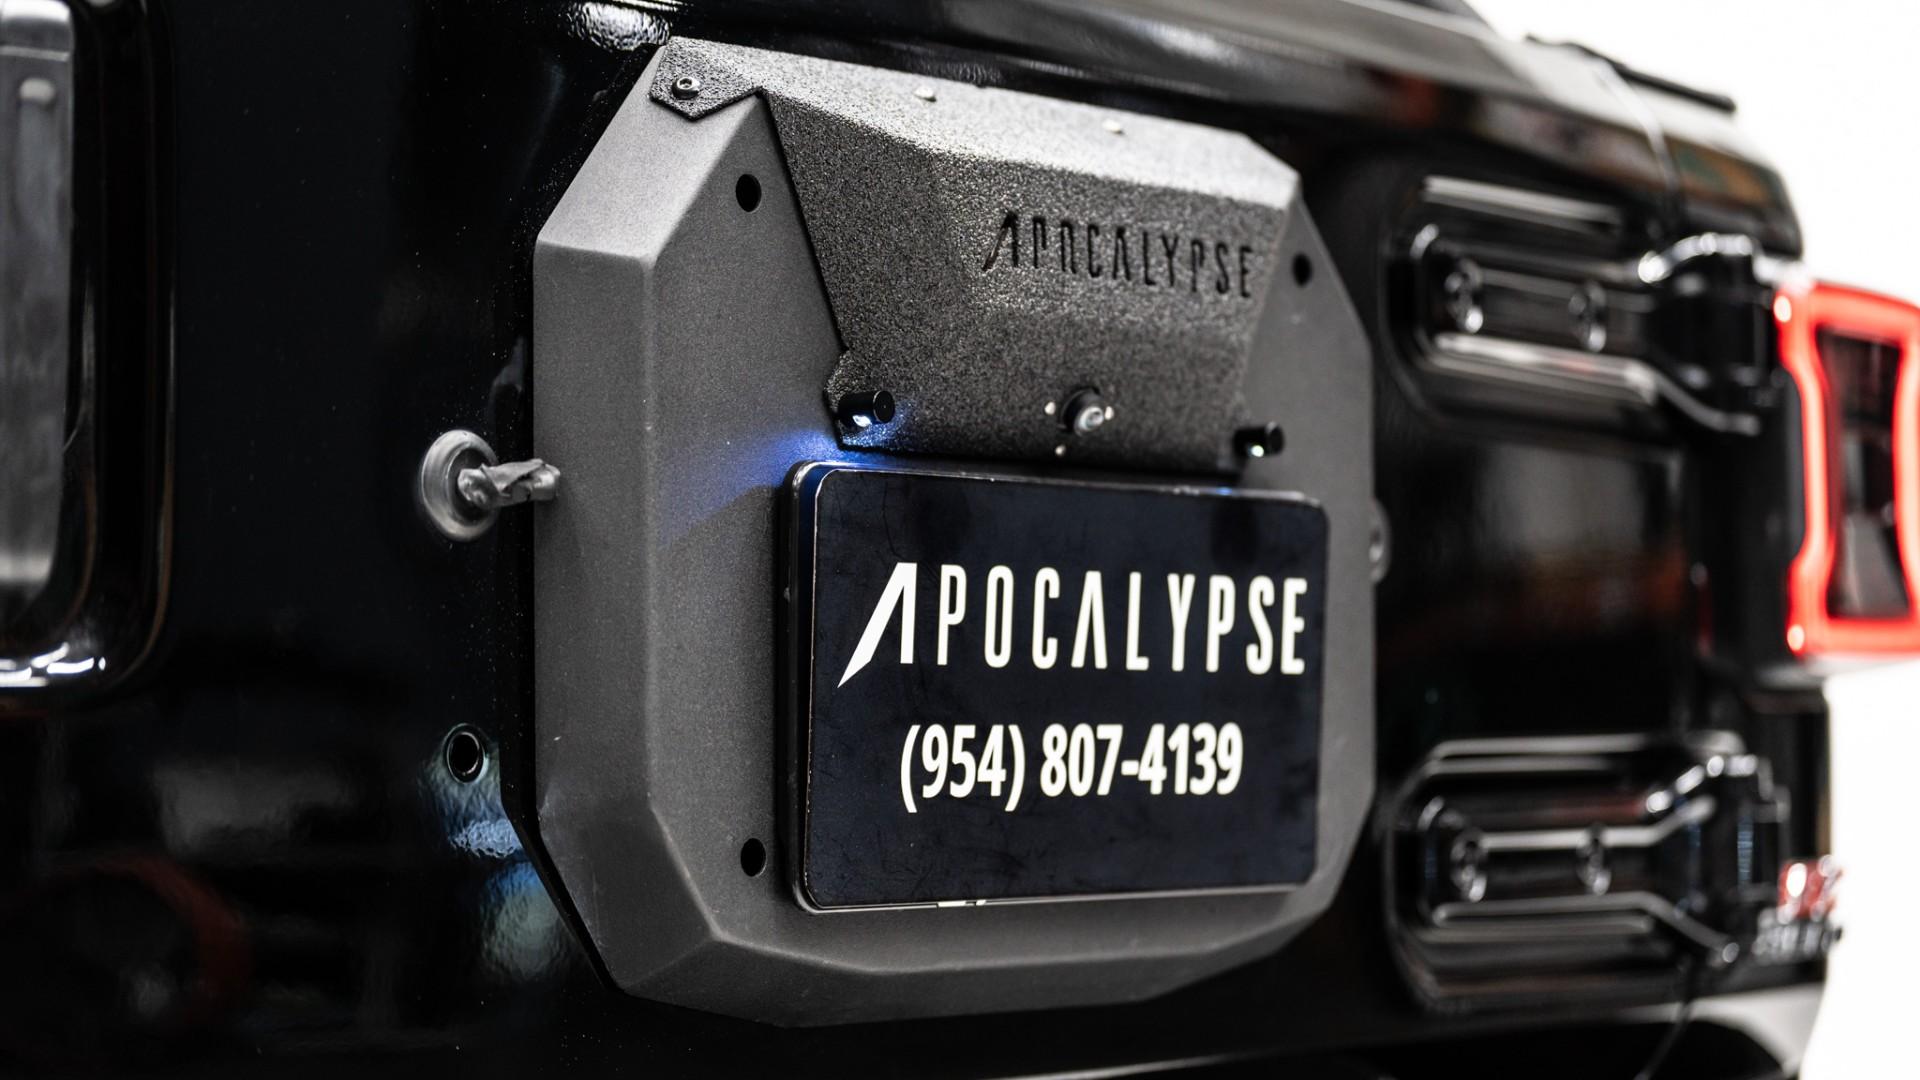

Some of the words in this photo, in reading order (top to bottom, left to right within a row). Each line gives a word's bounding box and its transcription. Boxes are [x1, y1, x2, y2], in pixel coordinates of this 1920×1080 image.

[981, 210, 1254, 299] APOCALYPSE
[837, 562, 1308, 688] APOCALYPSE
[900, 723, 1026, 814] (954)
[1040, 722, 1243, 798] 807-4139
